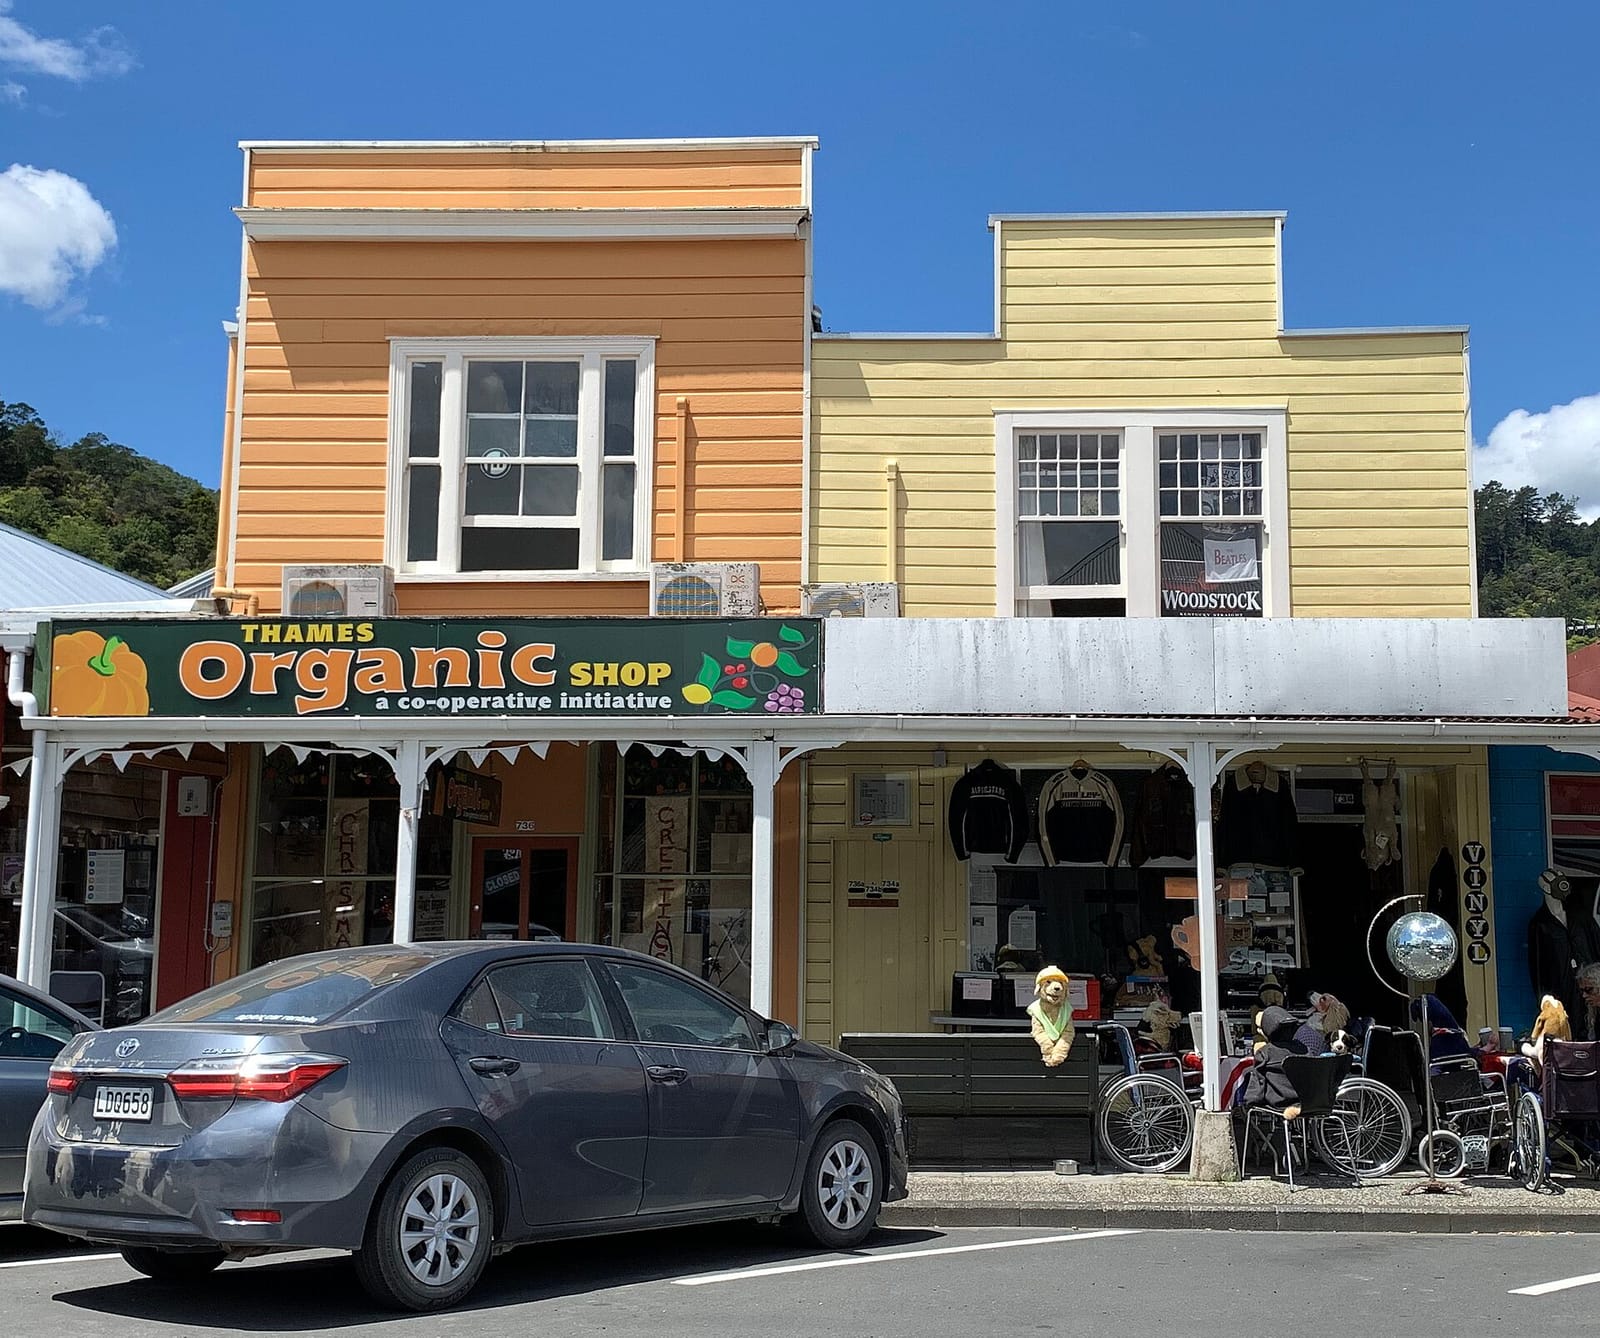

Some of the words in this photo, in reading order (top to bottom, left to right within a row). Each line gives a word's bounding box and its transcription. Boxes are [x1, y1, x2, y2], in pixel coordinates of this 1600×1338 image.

[1162, 590, 1262, 610] WOODSTOCK
[241, 623, 375, 643] THAMES
[179, 630, 557, 714] Organic
[569, 662, 672, 687] SHOP
[375, 697, 389, 709] a
[397, 692, 551, 713] co-operative
[560, 692, 672, 709] initiative
[516, 821, 536, 830] 736
[485, 871, 521, 891] CLOSED
[1465, 844, 1488, 961] VINYL
[96, 1091, 149, 1114] LDQ658
